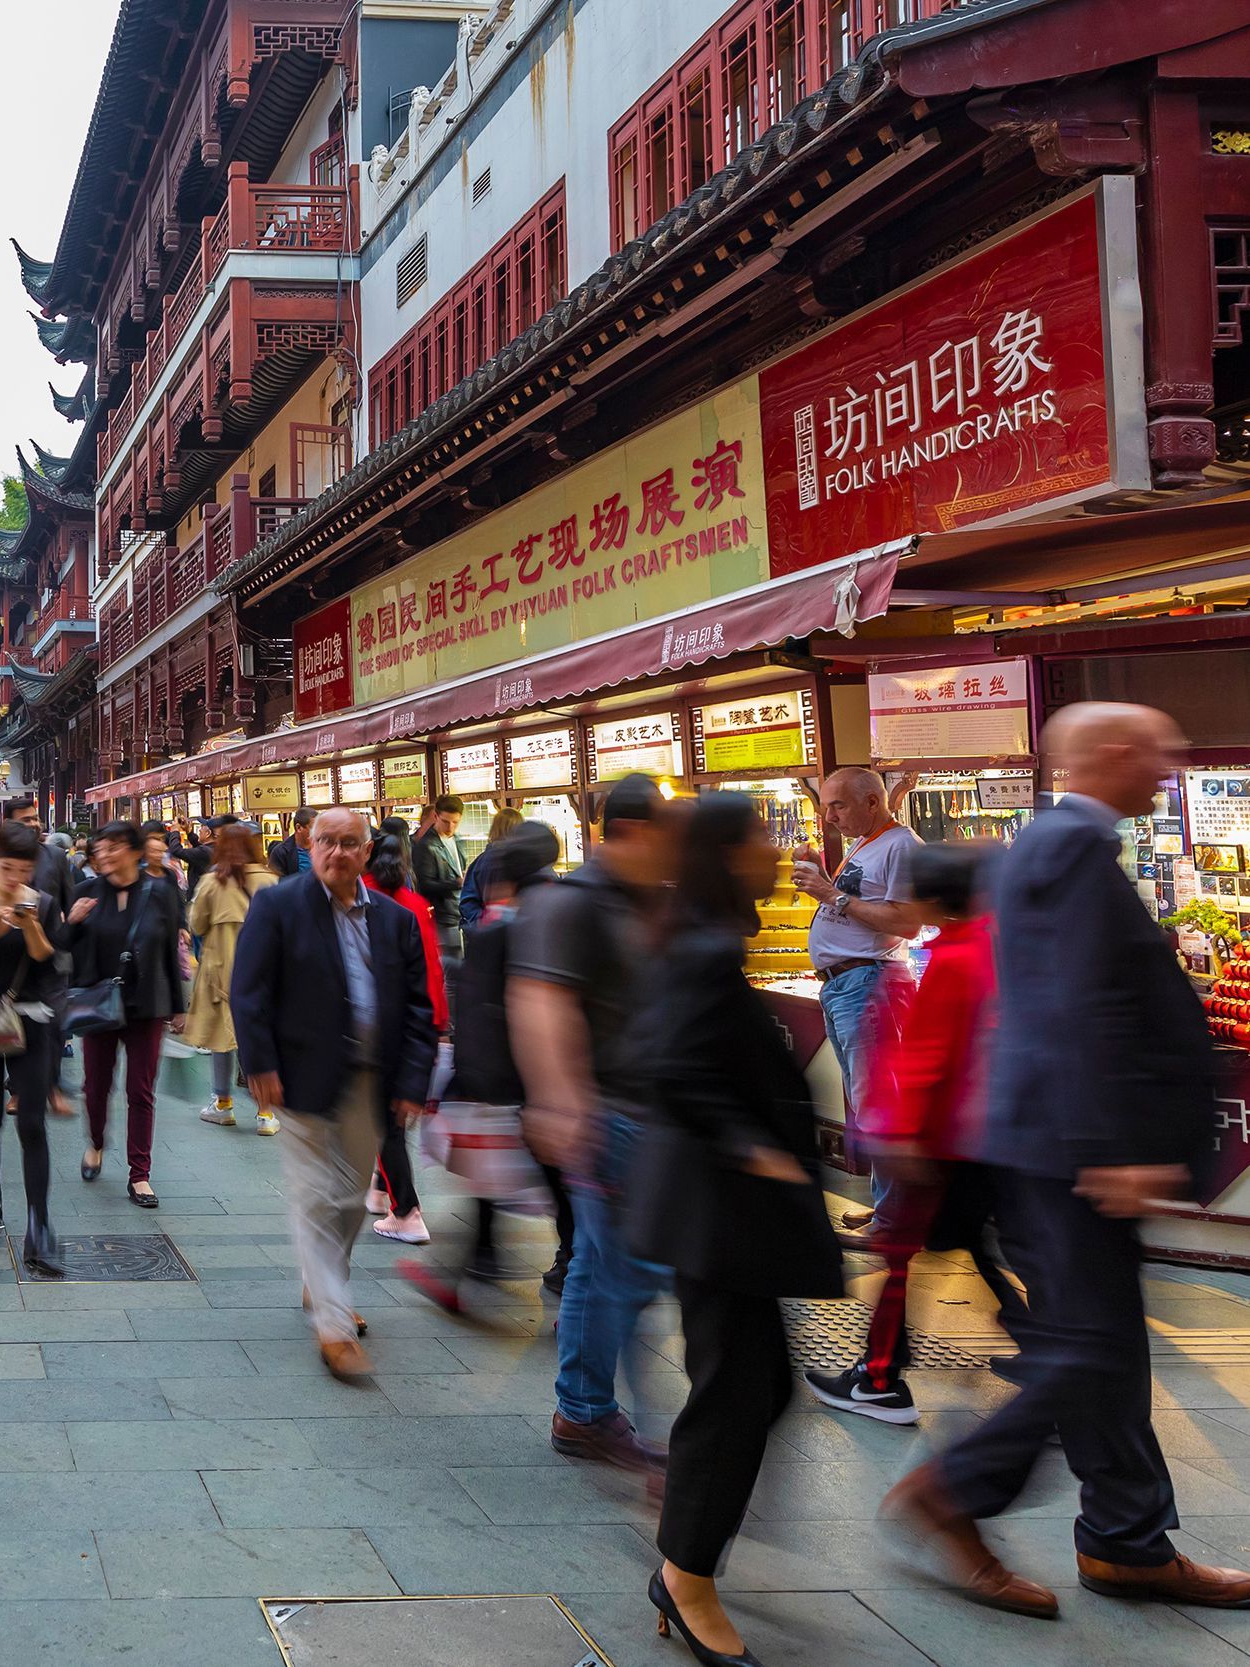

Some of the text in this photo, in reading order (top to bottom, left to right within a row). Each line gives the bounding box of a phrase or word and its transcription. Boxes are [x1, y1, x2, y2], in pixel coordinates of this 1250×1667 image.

[824, 308, 1054, 460] 坊间印象
[826, 389, 1056, 500] FOLK HANDICRAFTS
[356, 440, 747, 655] 豫园民间手工艺现场展演
[358, 514, 749, 678] THE SHOW OF SPECIAL SKILL BY YUYUAN FOLK CRAFTSMEN
[673, 622, 724, 653] 坊间印象
[684, 640, 725, 657] HANDICRAFTS
[304, 632, 343, 675] 坊间印象
[502, 678, 532, 699] 坊间印象
[914, 674, 1008, 701] 玻璃拉丝
[728, 703, 790, 726] 陶瓷艺术
[956, 703, 997, 711] drawing
[614, 723, 664, 742] 皮影艺术
